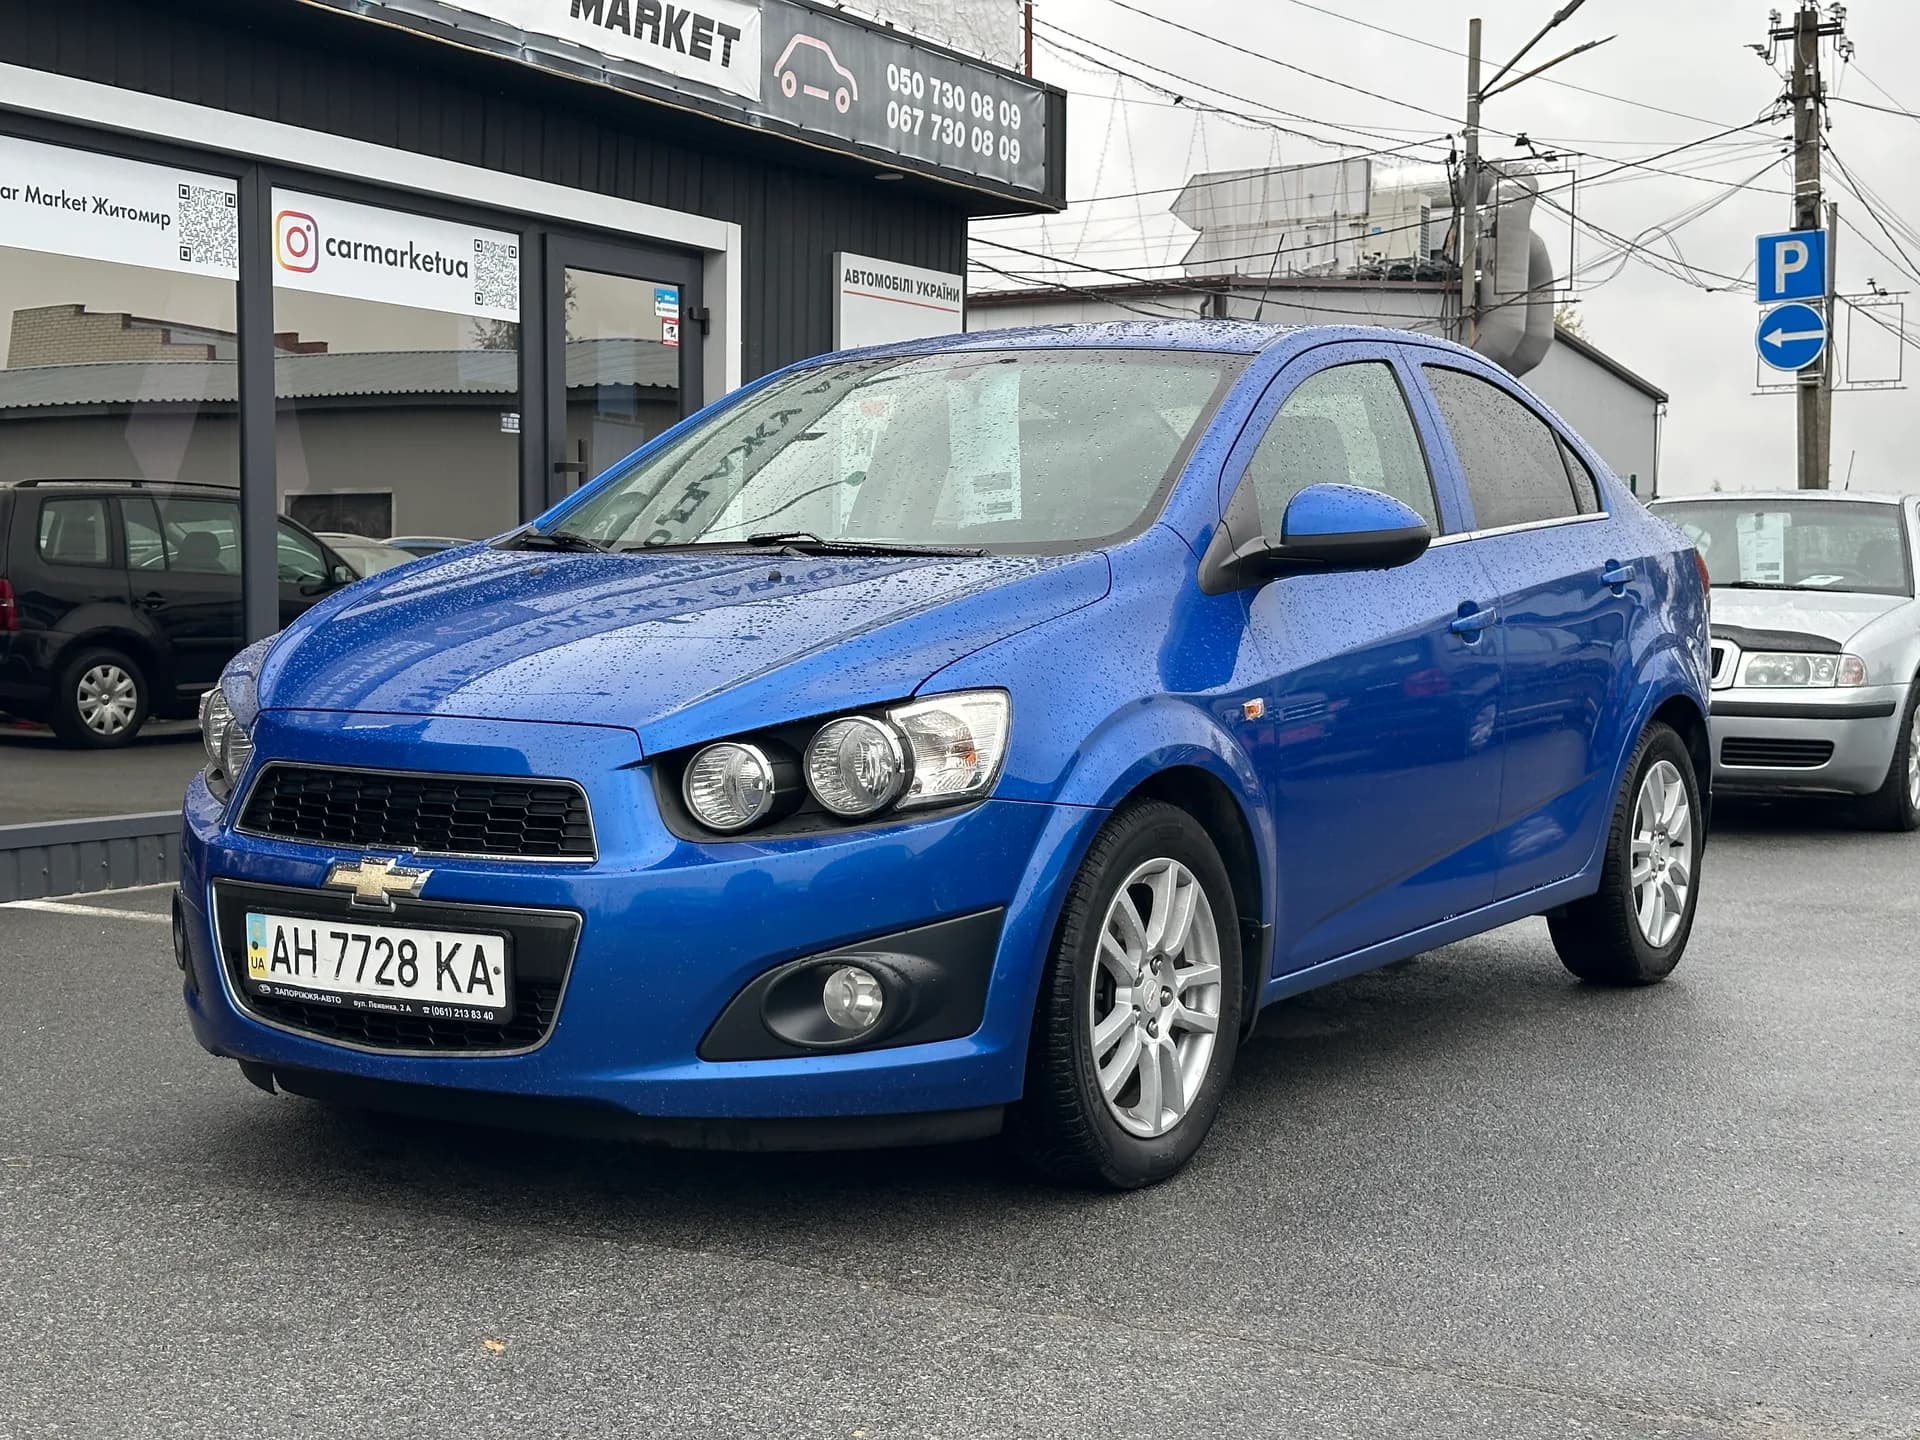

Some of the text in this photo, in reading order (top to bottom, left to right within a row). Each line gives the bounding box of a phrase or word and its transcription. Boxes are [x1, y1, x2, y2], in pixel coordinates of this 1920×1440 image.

[886, 63, 1022, 130] 050 730 08 09
[886, 100, 1021, 165] 067 730 08 09
[25, 184, 87, 212] Market
[92, 196, 171, 231] Житомир
[325, 237, 469, 279] carmarketua
[1775, 240, 1809, 293] P
[844, 268, 961, 303] АВТОМОБІЛІ УКРАЇНИ
[250, 957, 265, 971] UA
[270, 924, 494, 996] AH 7728 KA
[454, 1008, 469, 1019] 213
[483, 1010, 494, 1021] 40
